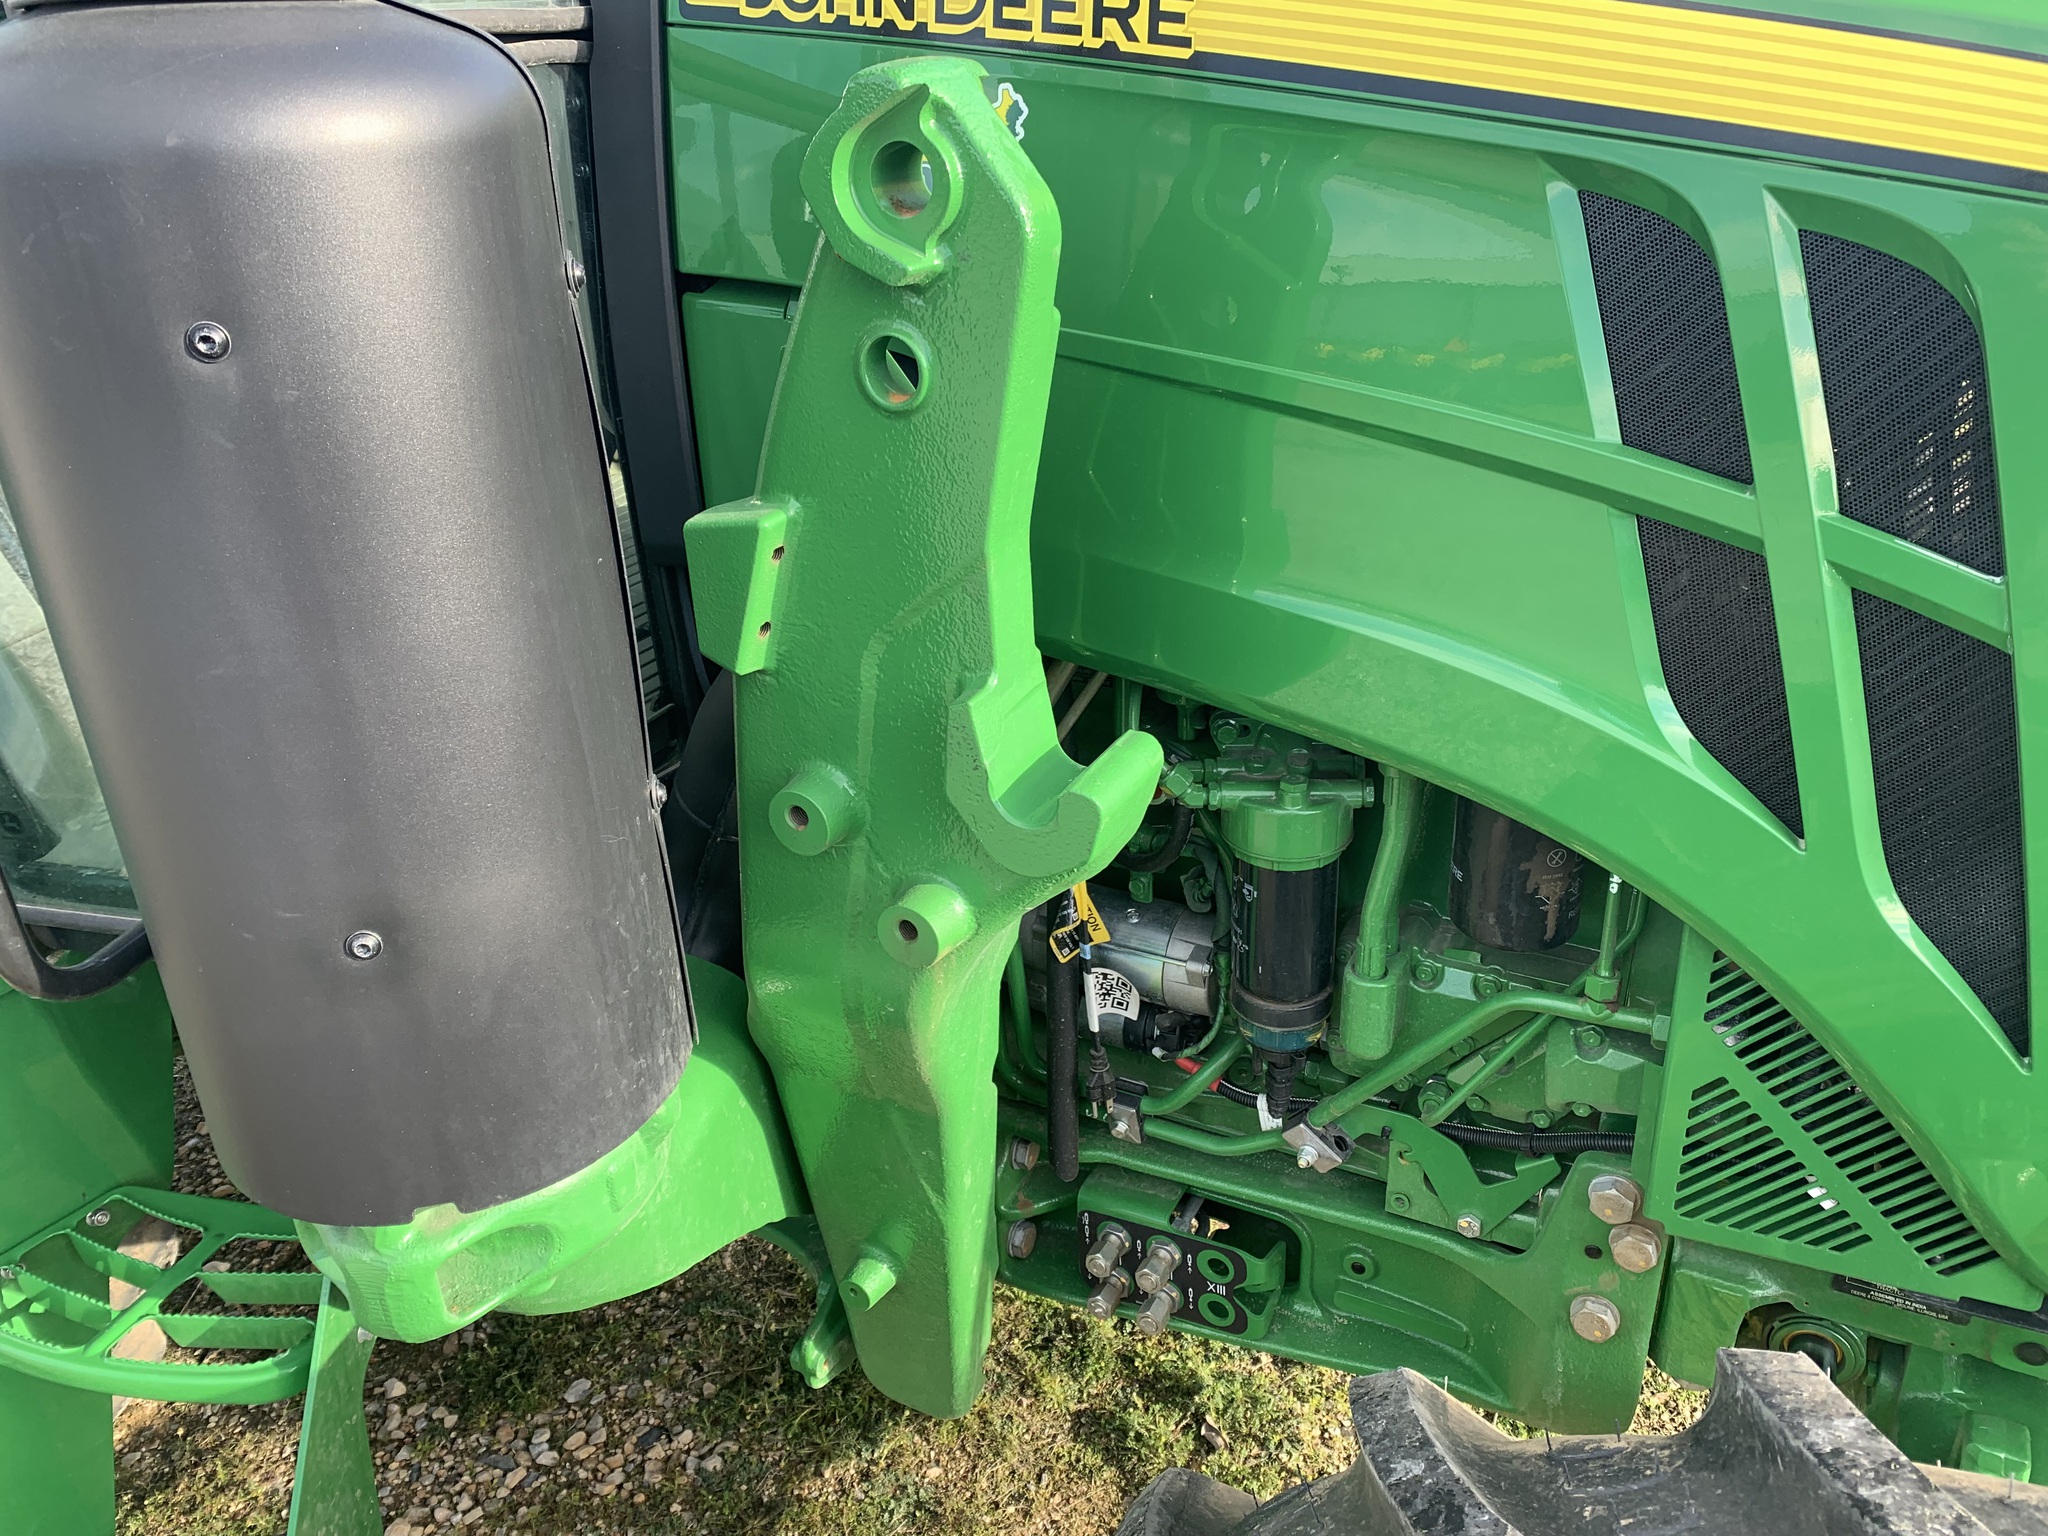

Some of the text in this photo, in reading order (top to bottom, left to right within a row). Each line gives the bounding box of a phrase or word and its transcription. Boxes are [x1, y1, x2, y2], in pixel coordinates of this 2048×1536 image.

[1206, 1281, 1227, 1296] XIII
[1850, 1289, 1867, 1298] DEERE
[1869, 1291, 1905, 1304] ASSEMBLED
[1912, 1302, 1927, 1310] INDIA
